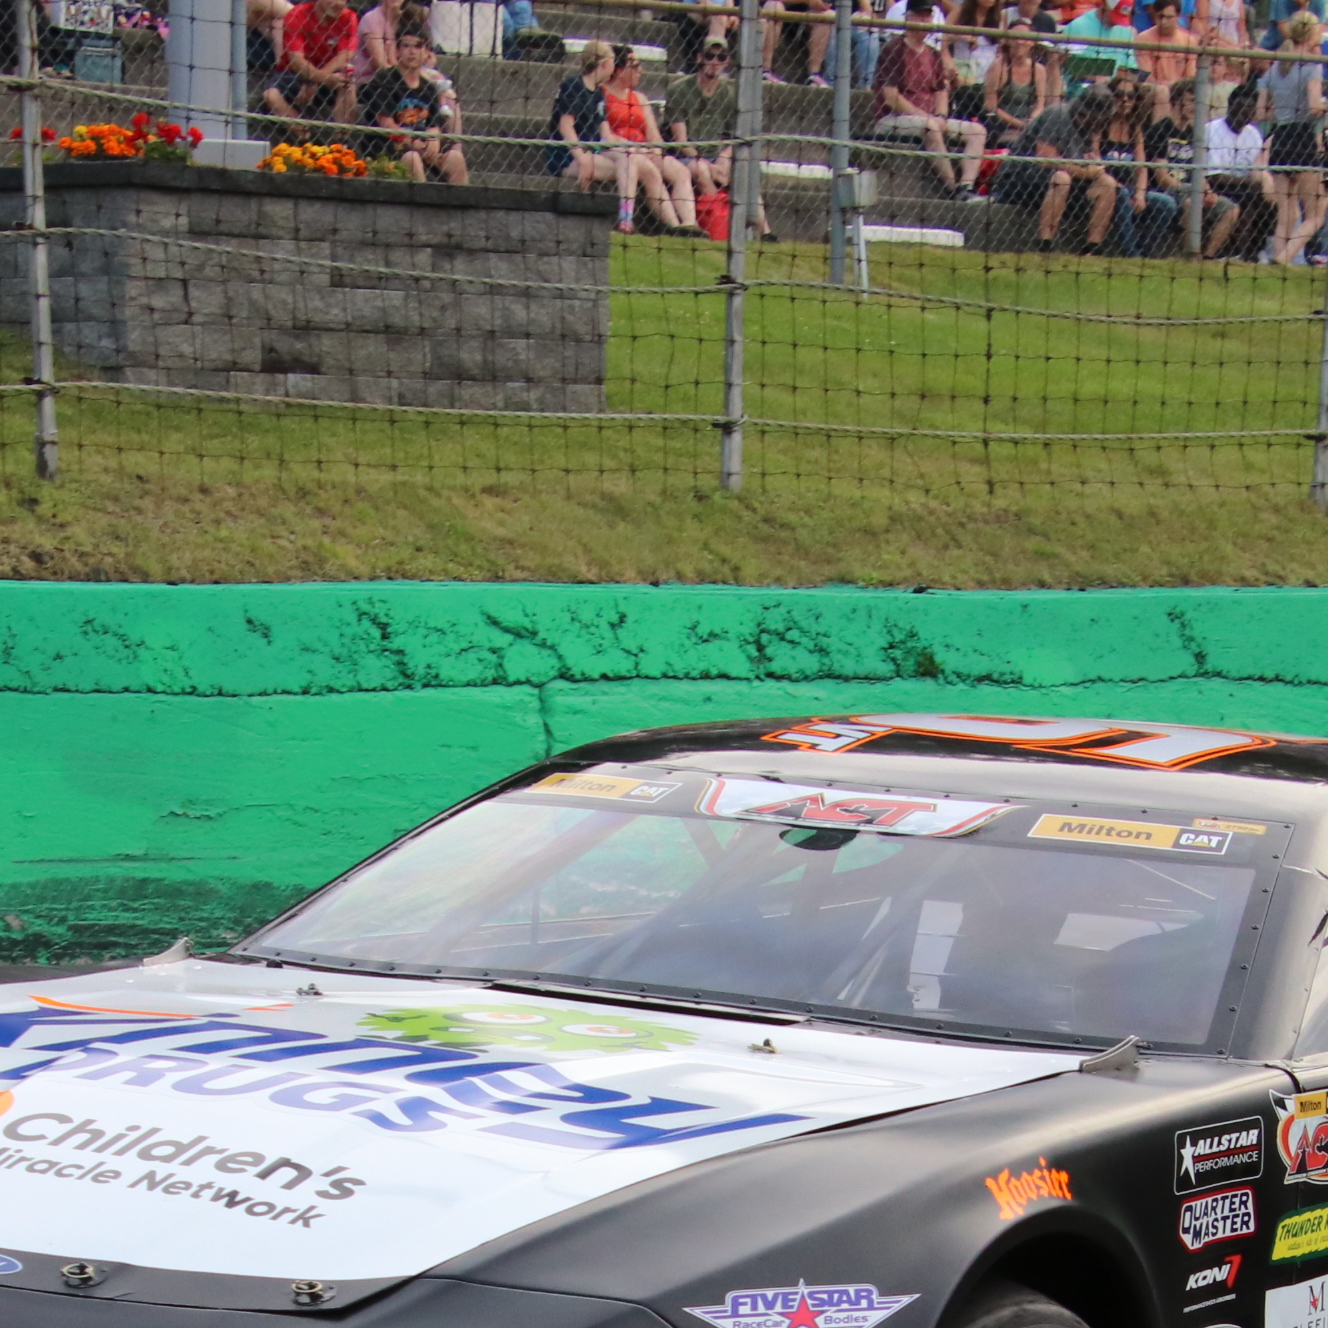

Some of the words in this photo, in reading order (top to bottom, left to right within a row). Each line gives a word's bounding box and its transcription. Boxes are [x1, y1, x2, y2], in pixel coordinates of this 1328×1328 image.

[549, 778, 616, 794] Milton
[633, 784, 670, 798] CAT
[1057, 821, 1152, 841] Milton
[1179, 833, 1224, 848] CAT
[1300, 1101, 1322, 1113] Milton
[1194, 1129, 1259, 1156] ALLSTAR
[2, 1113, 368, 1200] Children's
[1194, 1151, 1259, 1173] PERFORMANCE
[127, 1168, 327, 1229] Network
[1182, 1192, 1250, 1235] QUARTER
[1191, 1211, 1252, 1247] MASTER
[1279, 1215, 1323, 1241] THUNDER
[1185, 1263, 1230, 1291] KONI
[730, 1291, 797, 1316] FIVE
[806, 1288, 875, 1310] STAR
[824, 1315, 868, 1325] Bodies
